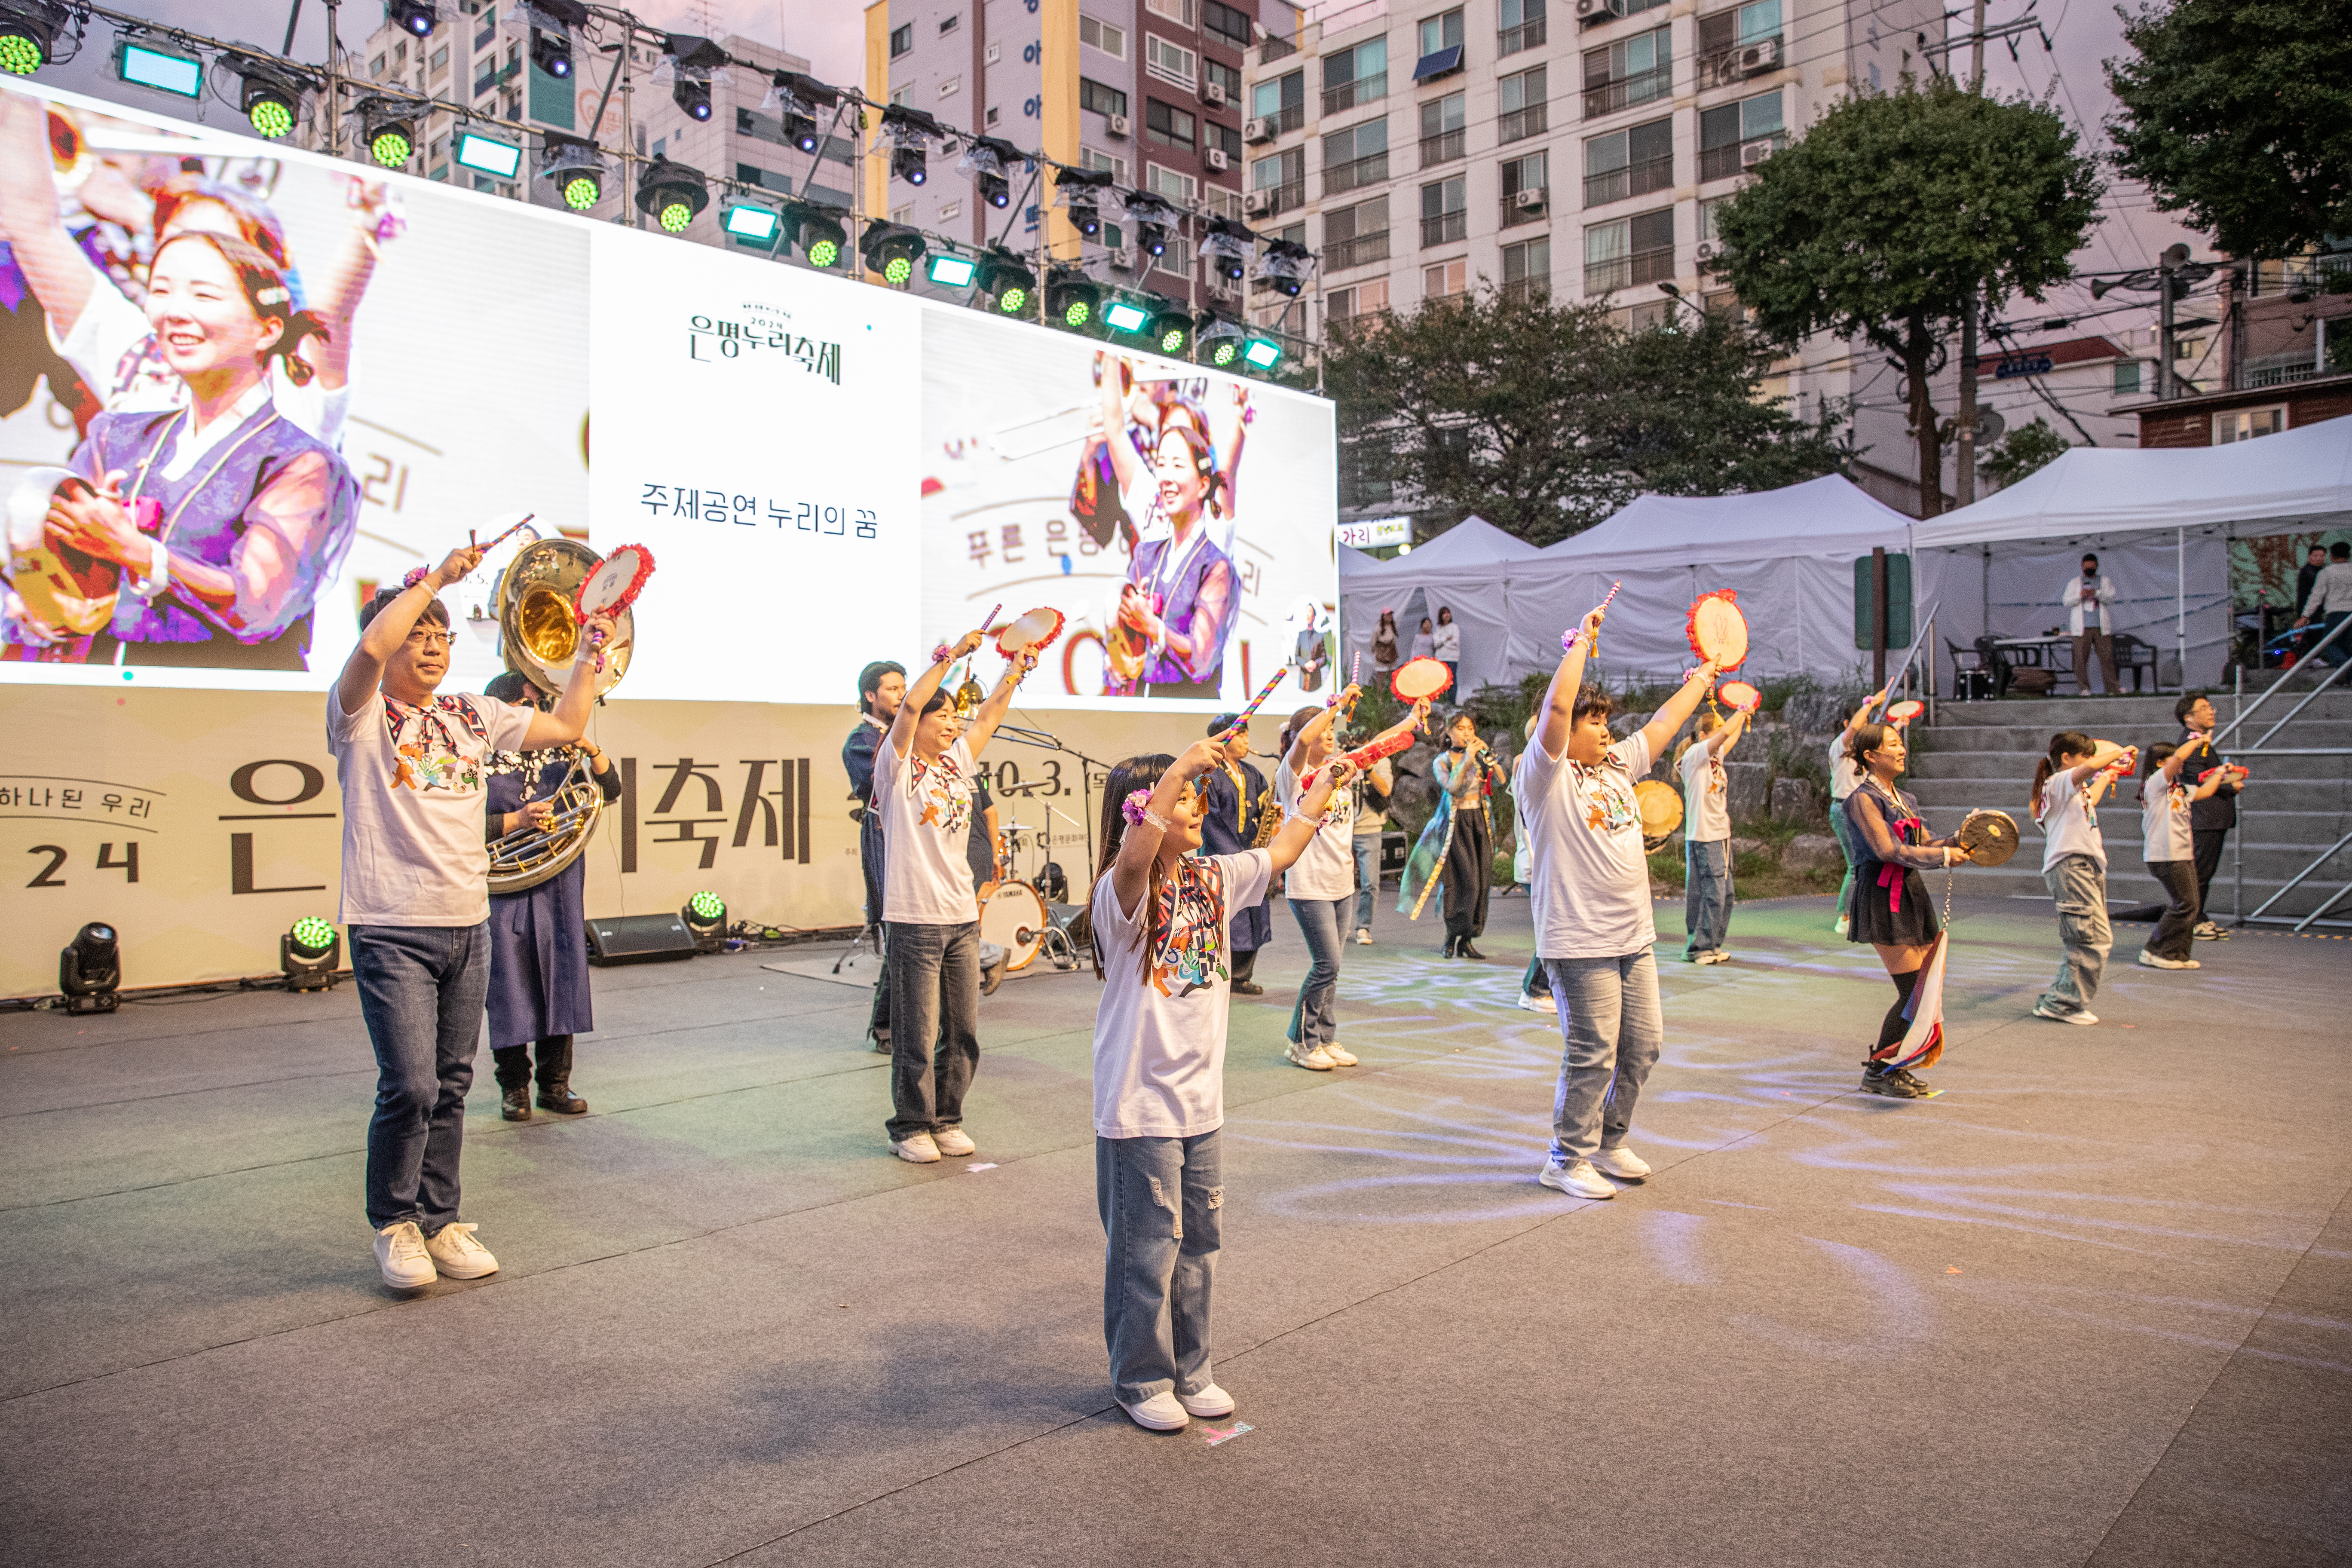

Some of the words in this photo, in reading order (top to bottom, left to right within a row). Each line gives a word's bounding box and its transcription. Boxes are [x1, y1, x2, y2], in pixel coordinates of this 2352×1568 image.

[751, 317, 782, 329] 2024
[641, 484, 756, 526] 주제공연
[768, 499, 844, 535] 누리의
[855, 509, 877, 539] 꿈
[968, 523, 1025, 569] 푸른
[0, 787, 83, 809] 하나된
[101, 794, 151, 818] 우리
